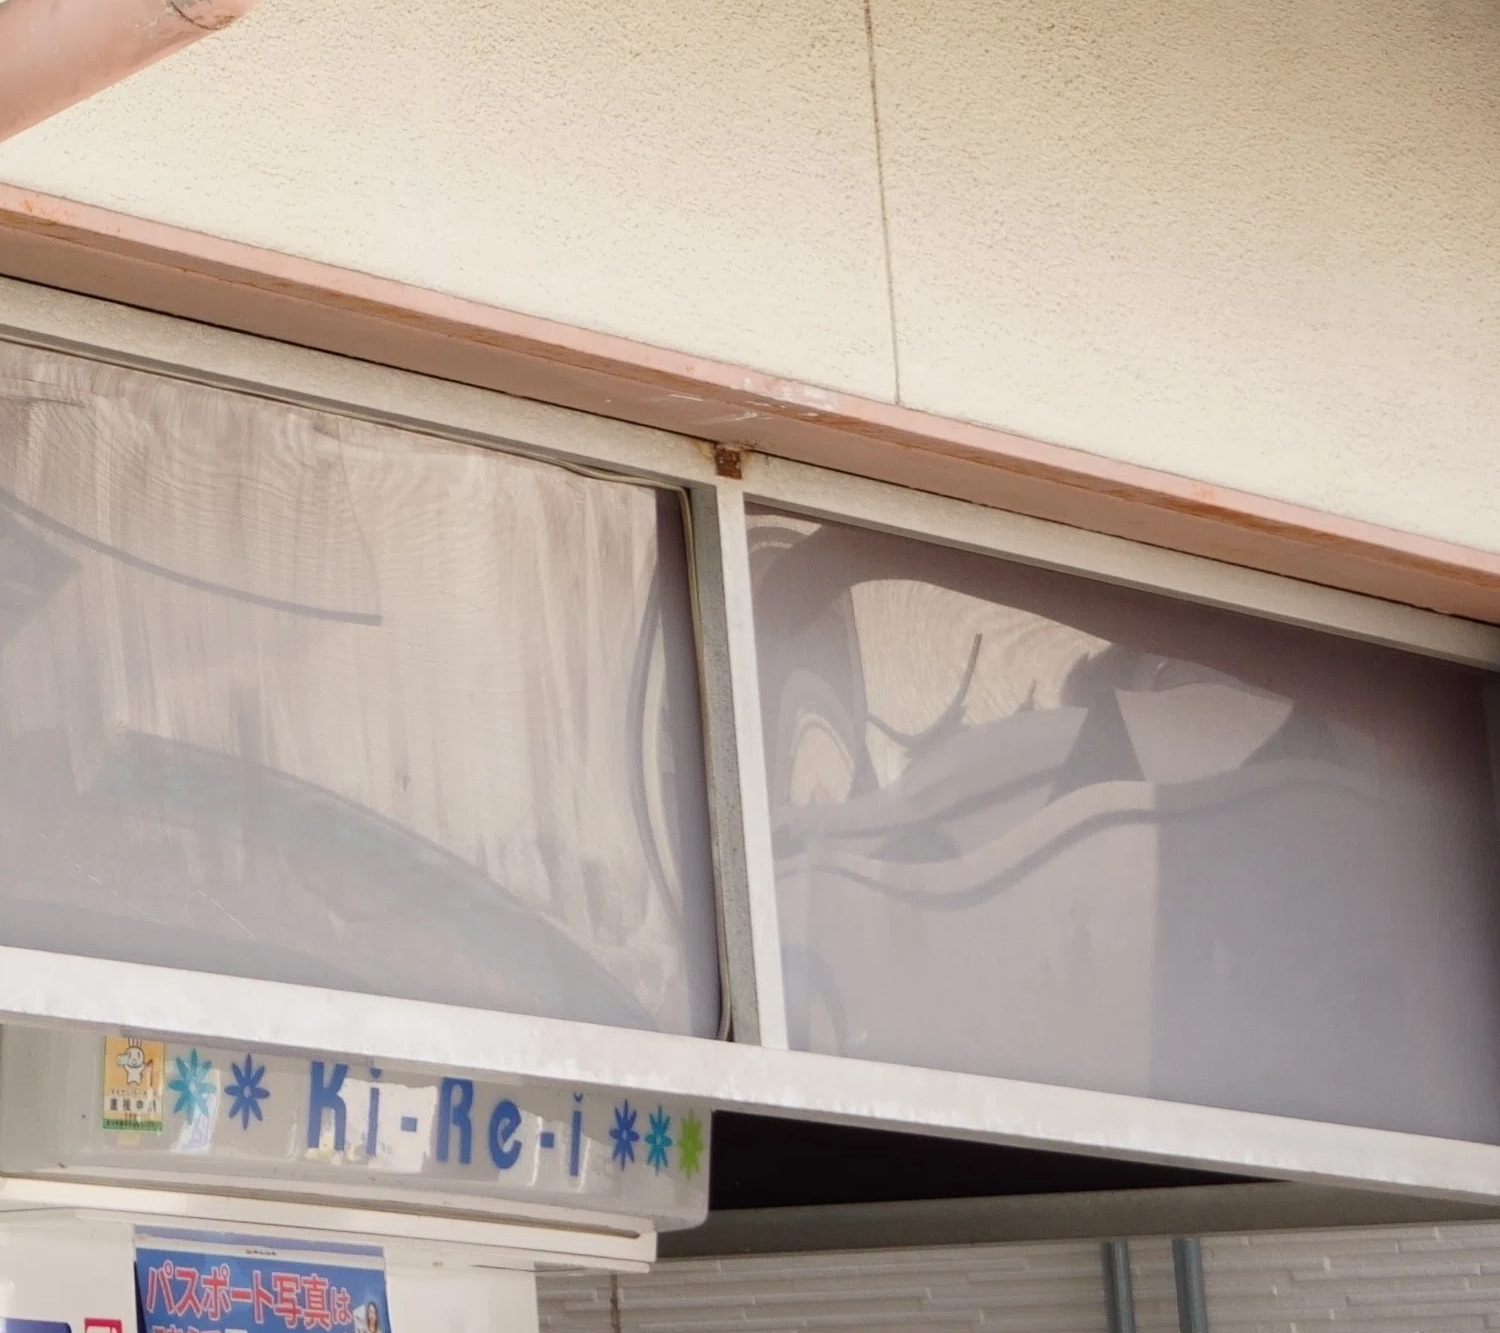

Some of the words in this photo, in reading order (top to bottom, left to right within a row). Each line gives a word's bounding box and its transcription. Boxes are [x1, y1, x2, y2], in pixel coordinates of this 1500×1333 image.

[307, 1060, 585, 1177] Ki-Re-i
[145, 1259, 352, 1331] パスポート写真は
